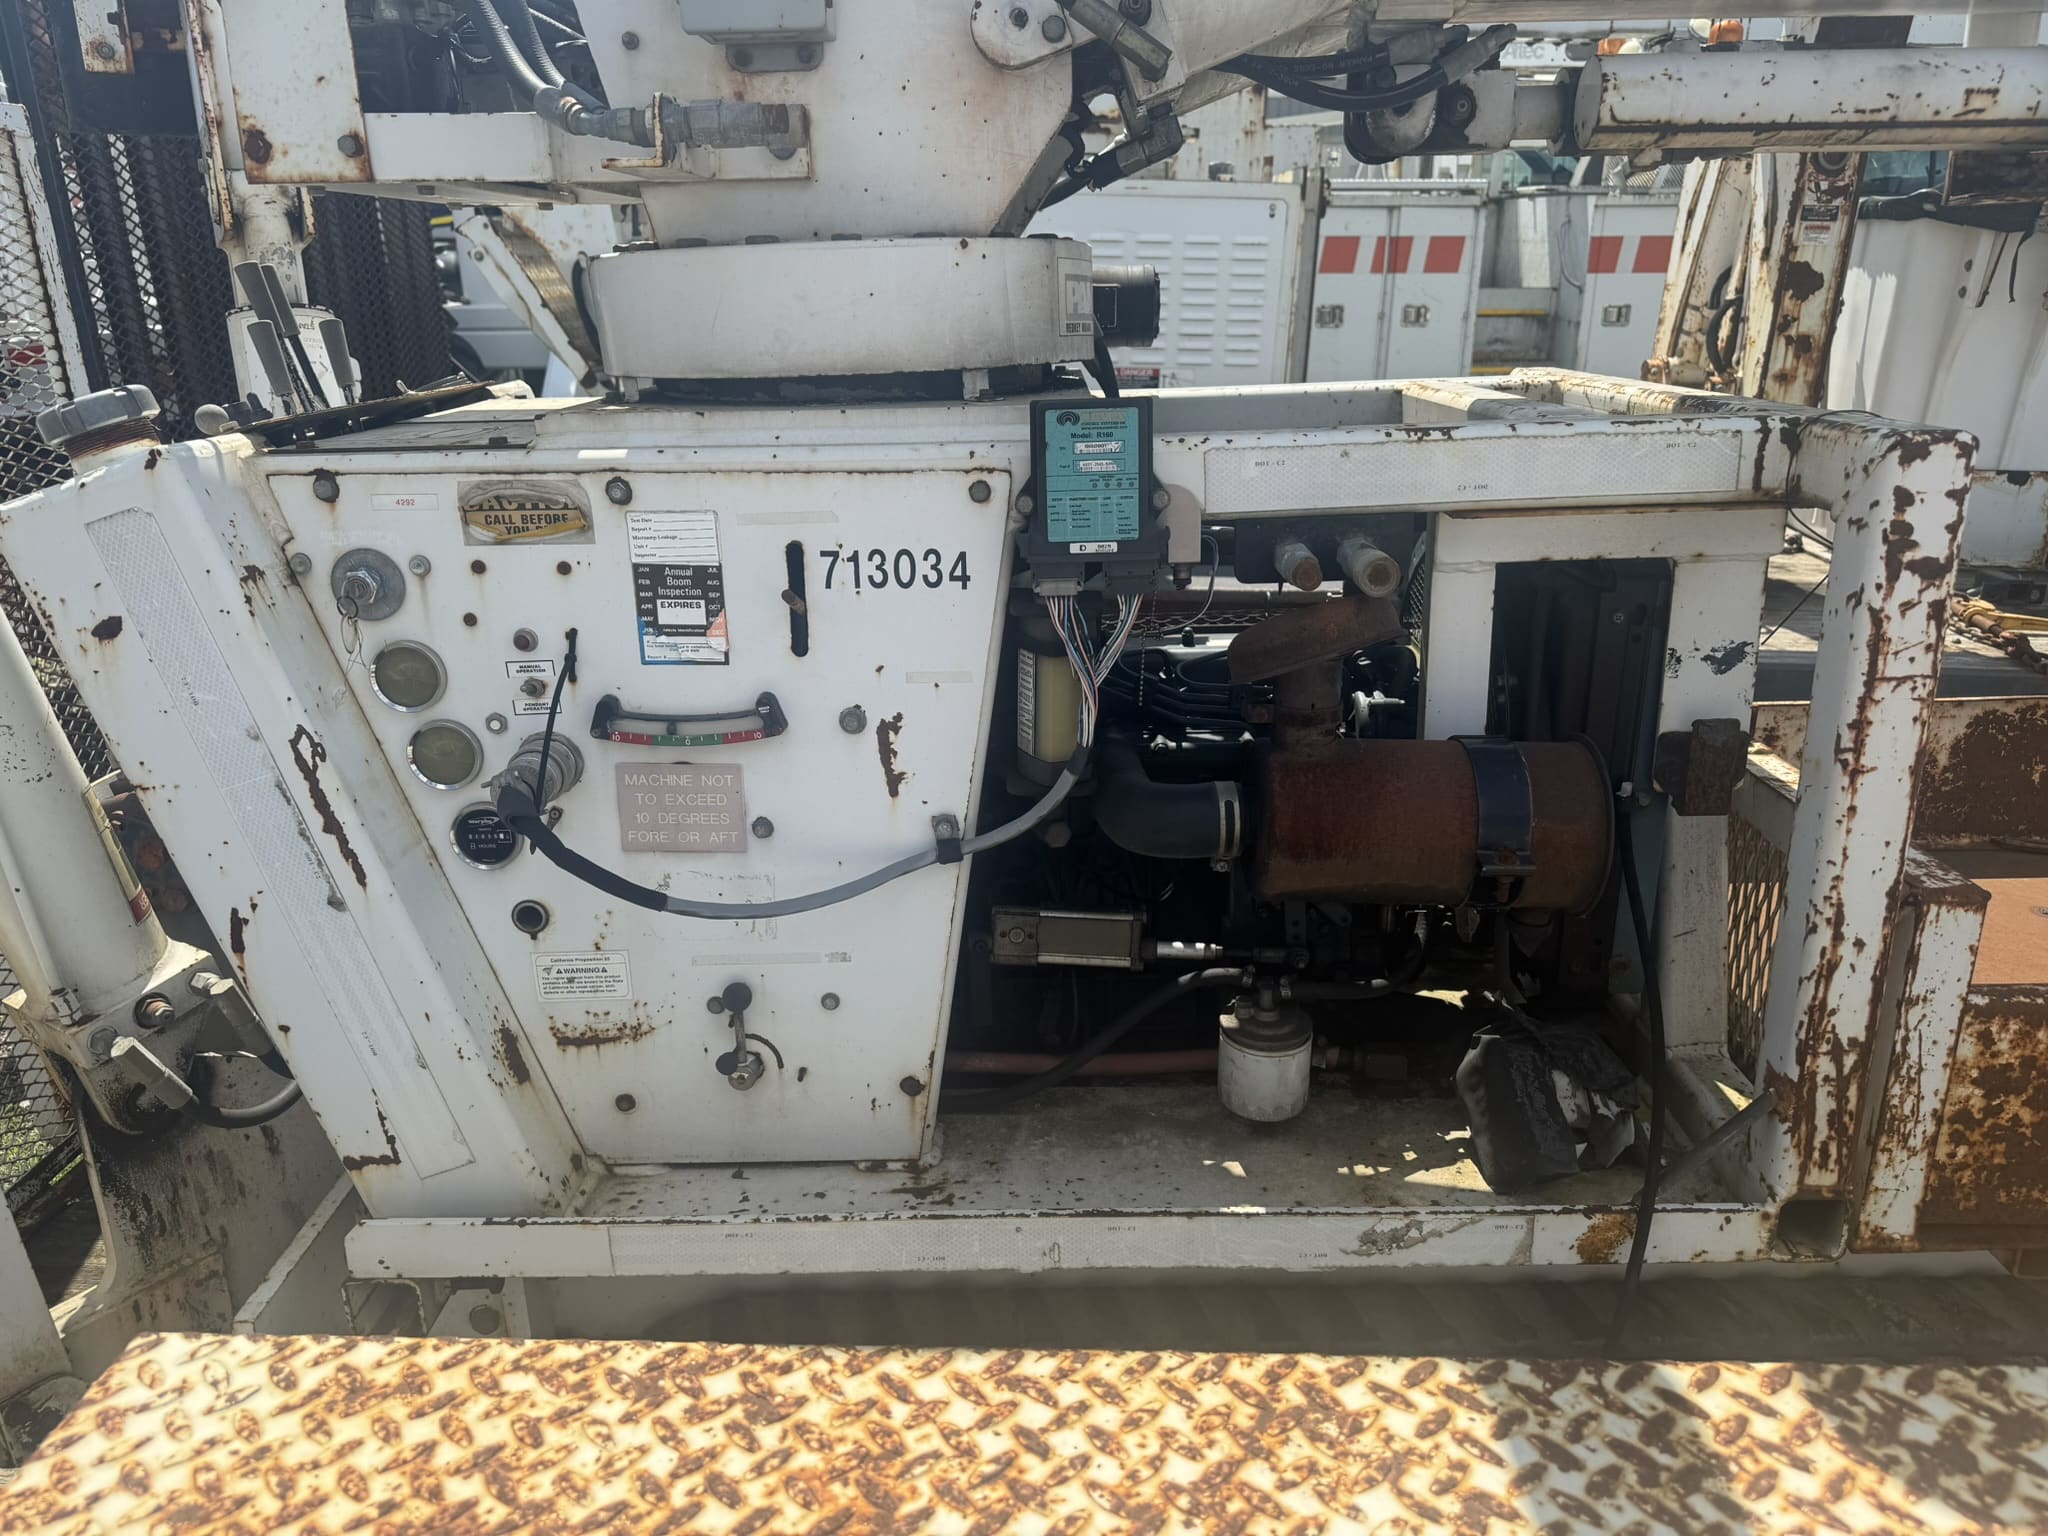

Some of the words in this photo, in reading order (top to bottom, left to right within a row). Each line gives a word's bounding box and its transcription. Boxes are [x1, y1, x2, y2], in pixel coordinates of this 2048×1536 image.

[395, 498, 416, 507] 4292
[484, 514, 516, 526] CALL
[520, 513, 569, 525] BEFORE
[1079, 544, 1087, 552] D
[664, 567, 693, 576] Annual
[820, 548, 971, 590] 713034
[666, 576, 692, 586] Boom
[657, 586, 702, 598] Inspection
[660, 601, 702, 609] EXPIRES
[611, 734, 621, 742] 10
[753, 731, 762, 740] 10
[684, 738, 691, 746] 0
[624, 774, 693, 787] MACHINE
[701, 774, 734, 787] NOT
[634, 793, 657, 806] TO
[665, 793, 728, 806] EXCEED
[635, 812, 650, 825] 10
[658, 812, 730, 825] DEGREES
[628, 830, 671, 843] FORE
[678, 831, 701, 843] OR
[709, 831, 739, 843] AFT
